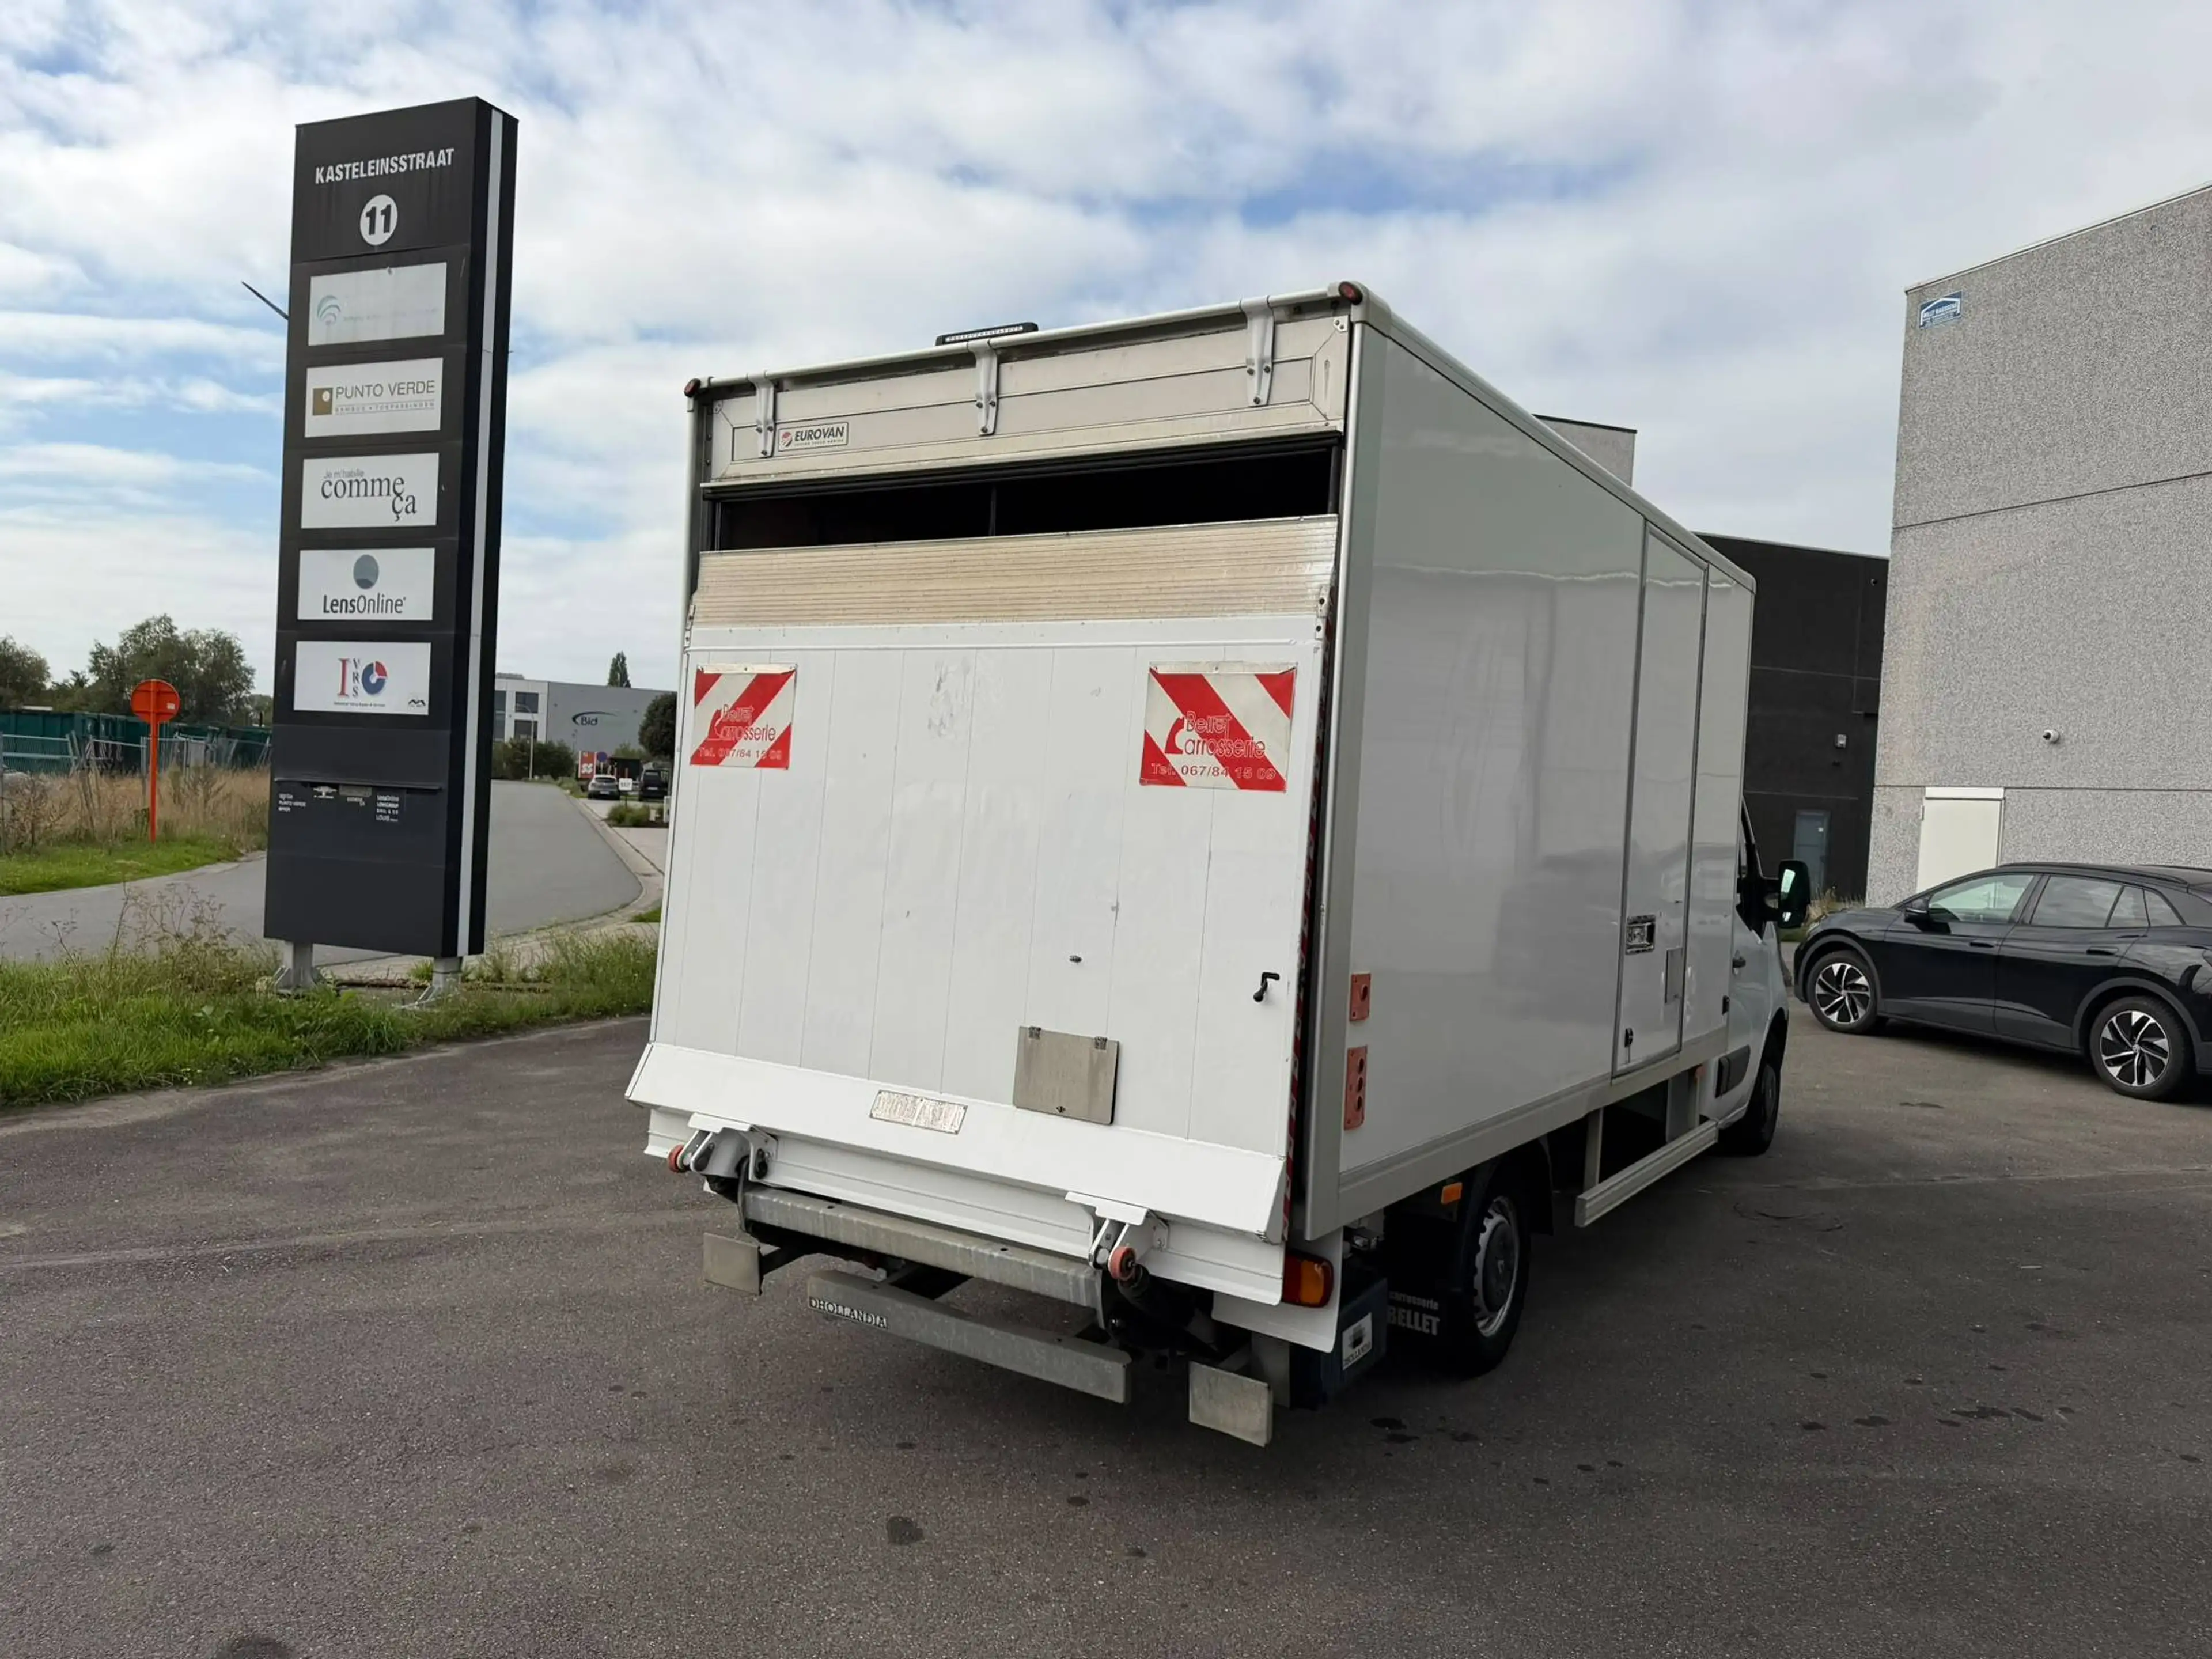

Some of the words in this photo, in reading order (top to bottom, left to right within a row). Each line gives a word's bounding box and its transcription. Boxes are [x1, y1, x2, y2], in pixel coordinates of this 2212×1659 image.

[315, 147, 454, 184] KASTELEINSSTRAAT
[365, 204, 392, 236] 11
[335, 383, 384, 399] PUNTO
[388, 380, 435, 396] VERDE
[794, 426, 845, 442] EUROVAN
[321, 476, 405, 499] comme
[391, 494, 417, 522] ça
[323, 592, 404, 615] LensOnline
[1181, 764, 1229, 778] 067/84
[1234, 767, 1253, 779] 15
[1387, 1305, 1441, 1336] BELLET
